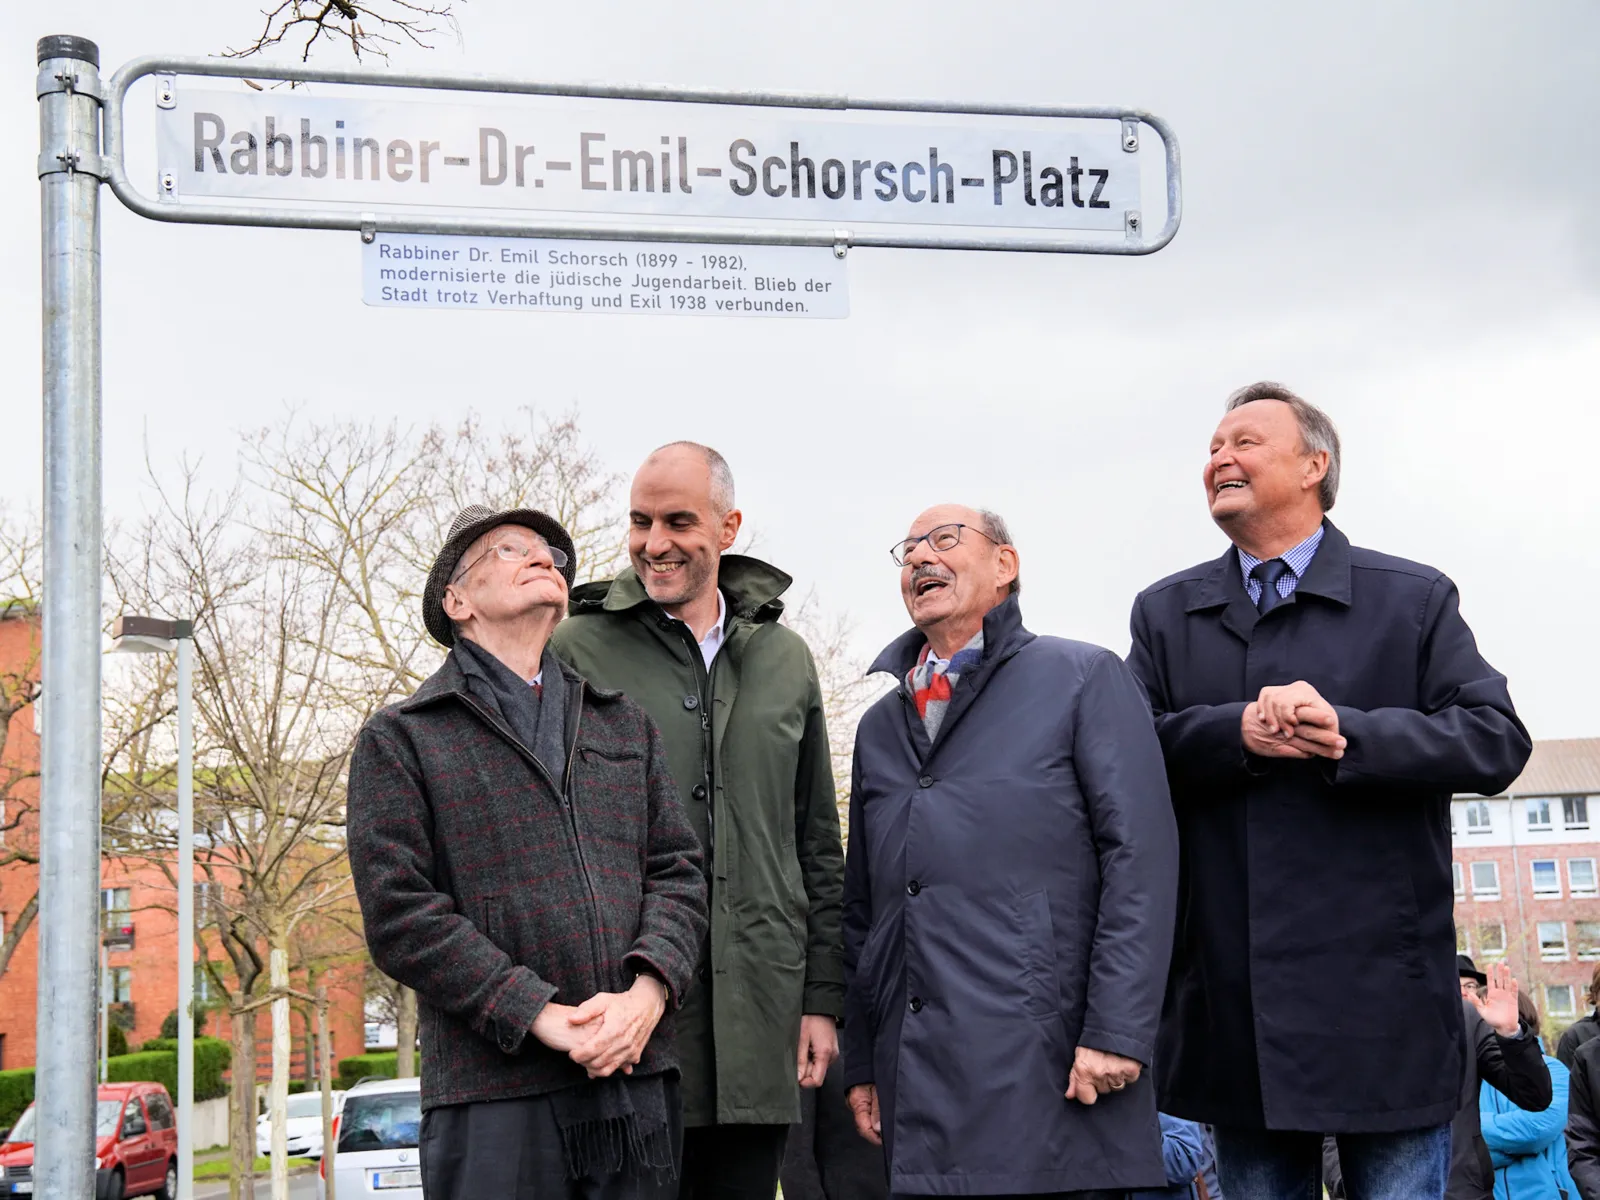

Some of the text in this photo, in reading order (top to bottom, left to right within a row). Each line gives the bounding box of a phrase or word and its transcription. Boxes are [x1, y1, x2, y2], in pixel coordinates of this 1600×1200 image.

[193, 111, 1110, 208] Rabbiner-Dr.-Emil-Schorsch-Platz
[379, 244, 459, 261] Rabbiner
[469, 248, 492, 262] Dr.
[501, 249, 539, 264] Emil
[548, 250, 628, 267] Schorsch
[636, 252, 678, 267] (1899
[701, 254, 748, 272] 1982),
[380, 267, 832, 293] modernisierte die jüdische Jugendarbeit. Blieb der
[381, 286, 809, 313] Stadt trotz Verhaftung und Exil 1938 verbunden.
